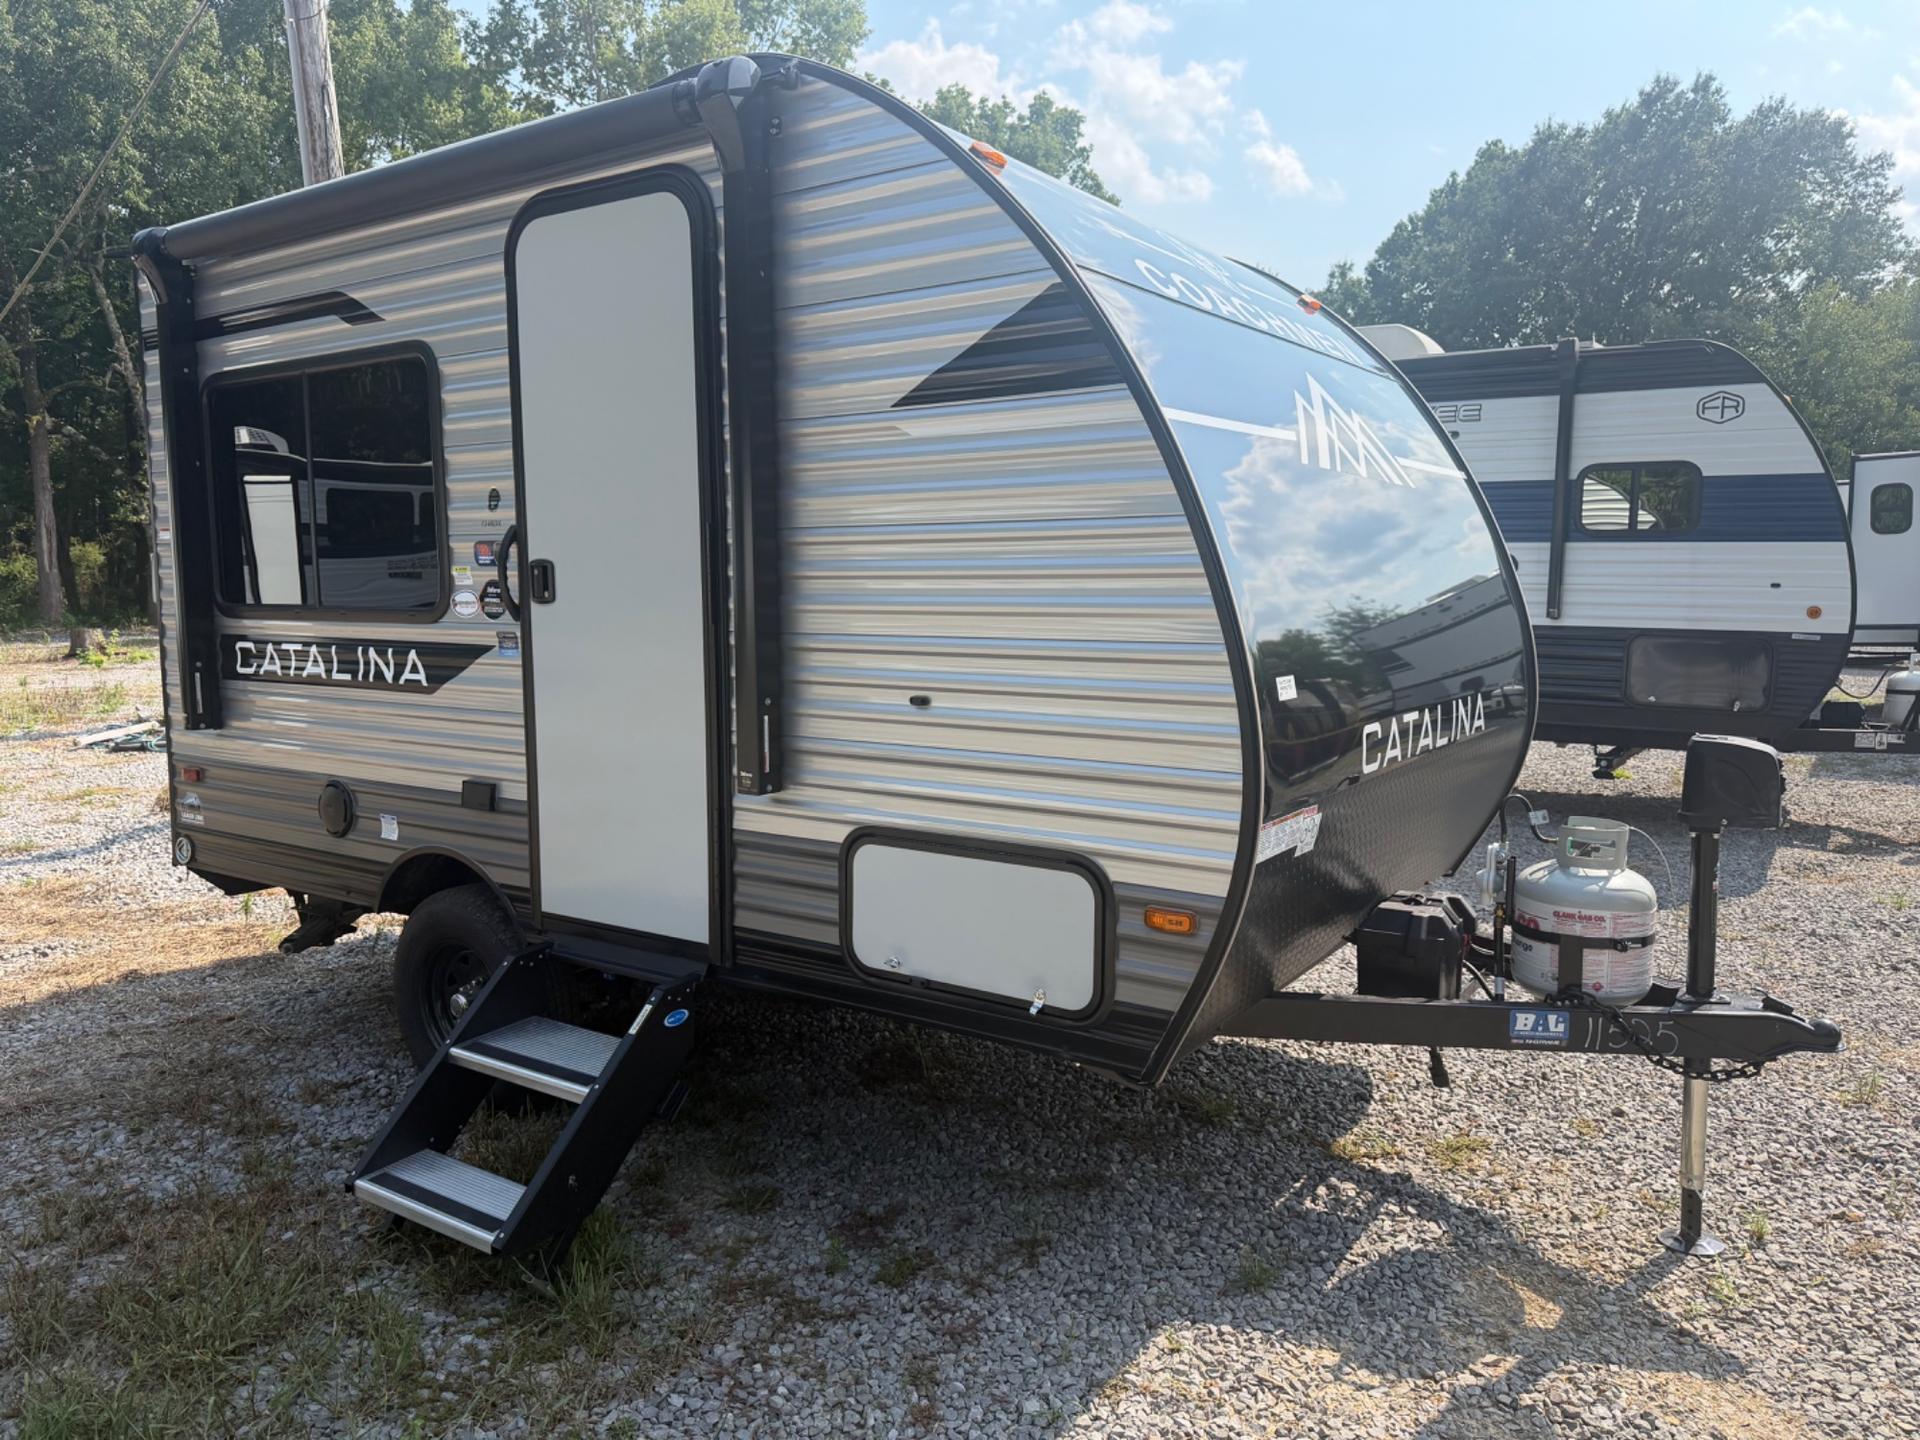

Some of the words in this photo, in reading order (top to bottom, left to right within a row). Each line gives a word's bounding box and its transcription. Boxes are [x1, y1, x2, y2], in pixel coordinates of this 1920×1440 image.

[1134, 258, 1363, 366] COACHMEN
[235, 641, 428, 687] CATALINA
[1362, 692, 1485, 774] CATALINA
